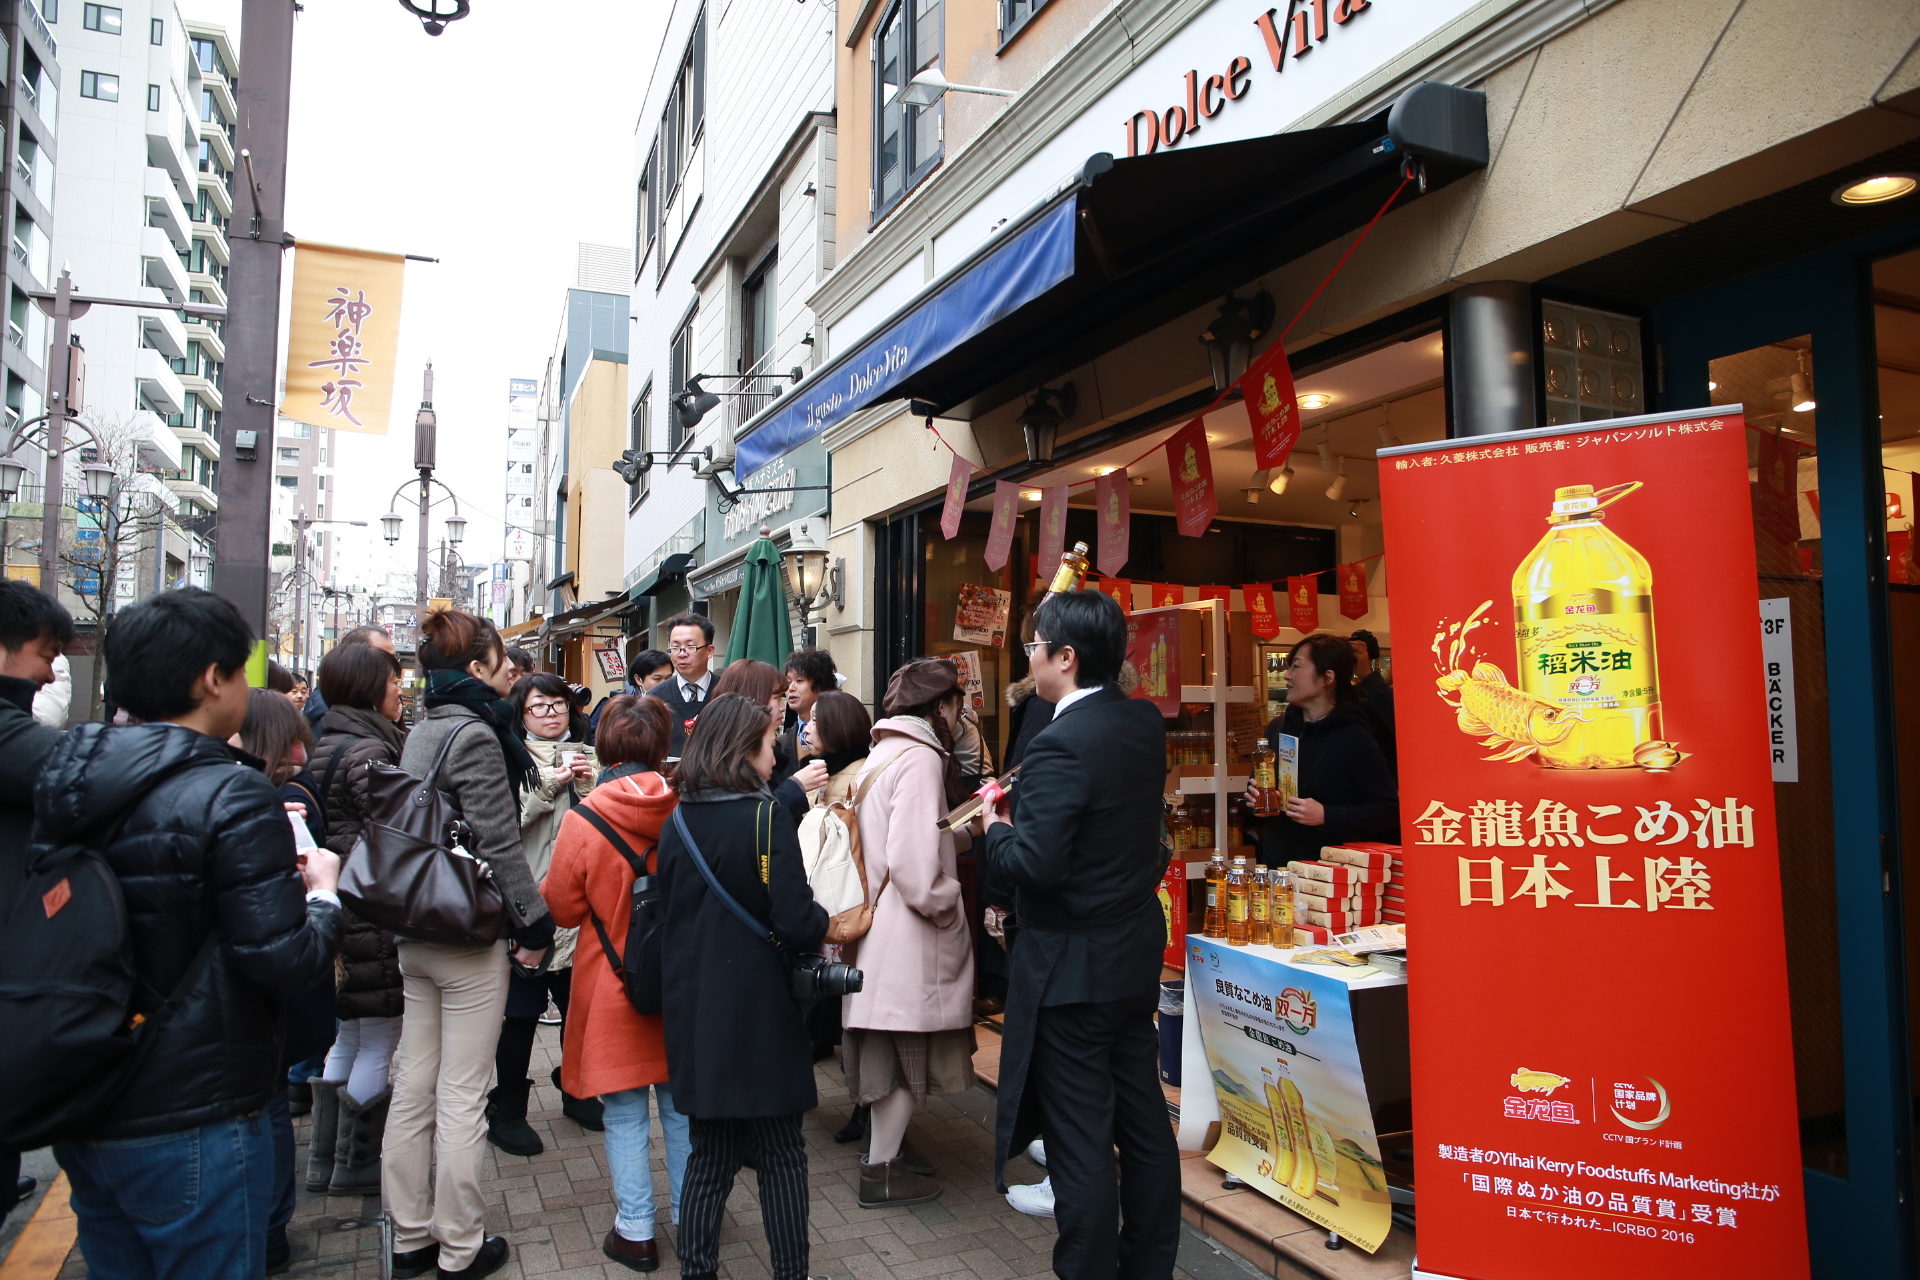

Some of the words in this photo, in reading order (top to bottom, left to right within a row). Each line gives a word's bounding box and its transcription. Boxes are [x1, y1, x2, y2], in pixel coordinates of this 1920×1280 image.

[1123, 56, 1252, 158] Dolce
[307, 286, 374, 428] 神楽坂
[806, 402, 814, 428] il
[814, 392, 843, 431] gusto
[848, 363, 884, 401] Dolce
[884, 344, 909, 377] Vita
[1565, 604, 1597, 615] 金龙鱼
[1764, 618, 1785, 635] 3F
[1537, 649, 1632, 676] 稻米油
[1767, 661, 1785, 764] BÄCKER
[1412, 796, 1755, 849] 金龍魚こめ油
[1457, 854, 1715, 912] 日本上陸
[1215, 978, 1273, 1013] 良質なこめ油
[1277, 998, 1316, 1027] 双一万
[1503, 1096, 1576, 1124] 金龙鱼
[1614, 1089, 1657, 1102] 国家品牌
[1615, 1099, 1636, 1110] 计划
[1602, 1133, 1624, 1142] CCTV
[1438, 1143, 1535, 1169] 製造者のYihai
[1536, 1156, 1575, 1178] Kerry
[1577, 1161, 1657, 1185] Foodstuffs
[1659, 1171, 1781, 1202] Marketing社が
[1463, 1172, 1738, 1229] 「国際ぬか油の品質賞」受賞
[1661, 1228, 1695, 1244] 2016
